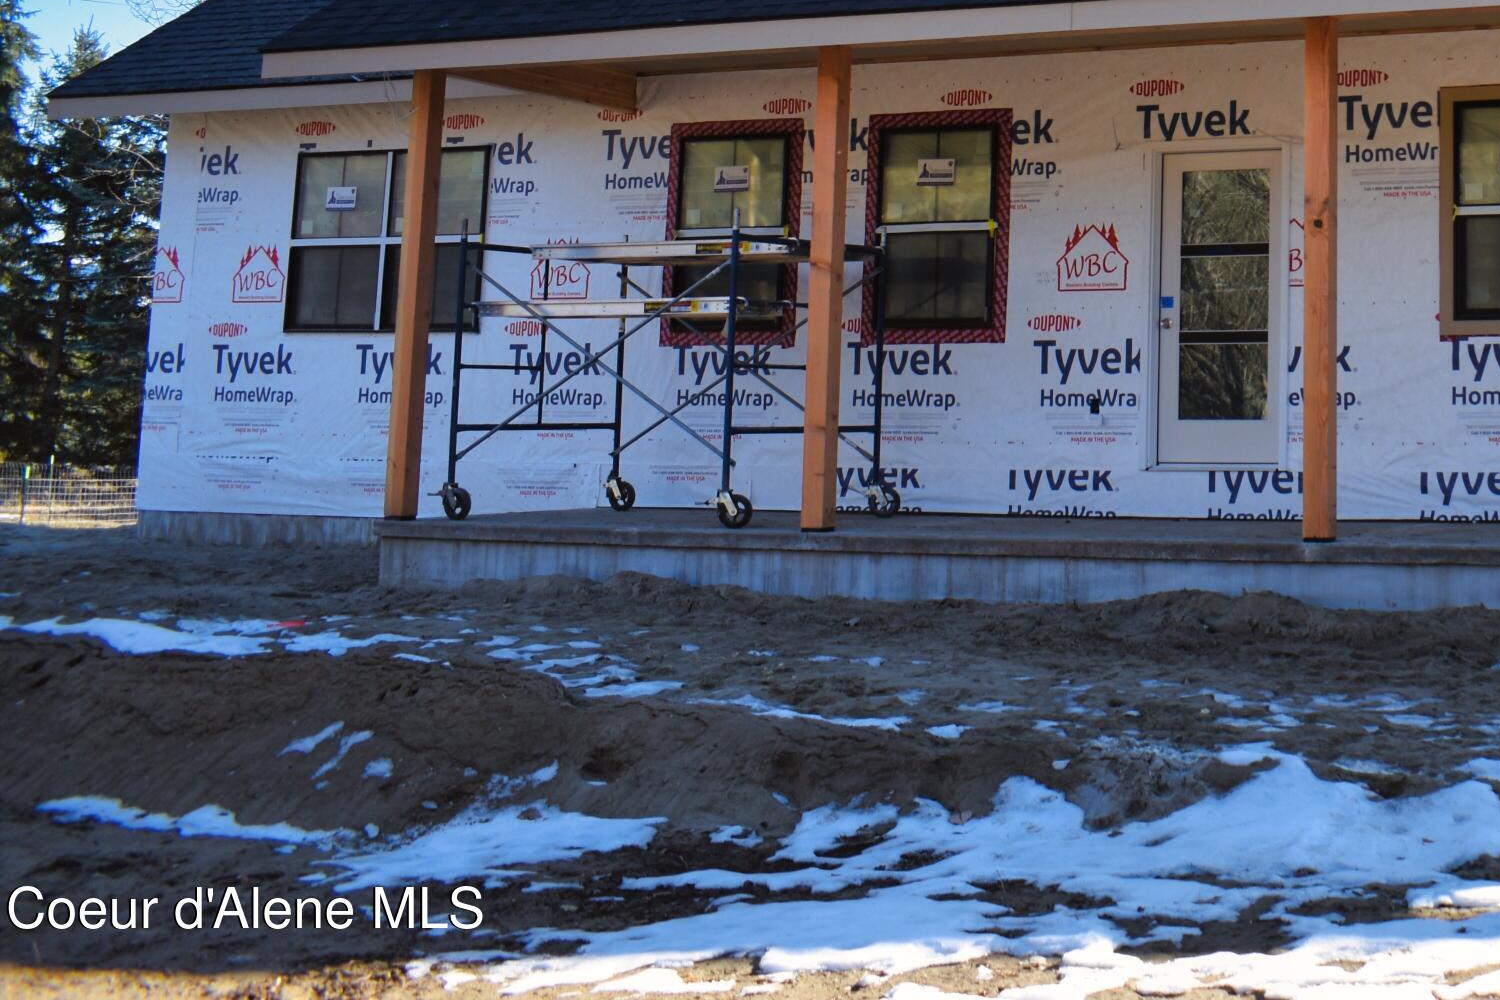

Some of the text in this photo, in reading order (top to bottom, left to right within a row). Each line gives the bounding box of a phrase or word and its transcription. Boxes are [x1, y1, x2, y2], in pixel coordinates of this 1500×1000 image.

[1136, 80, 1178, 96] DUPONT
[1337, 69, 1382, 87] DUPONT
[768, 98, 807, 115] DUPONT
[947, 89, 987, 106] DUPONT
[447, 114, 480, 130] DUPONT
[1136, 100, 1251, 142] Tyvek
[1338, 90, 1440, 140] Tyve
[300, 121, 332, 136] DUPONT
[602, 129, 671, 170] Tyve
[1345, 142, 1438, 163] HomeWr
[605, 173, 669, 190] HomeW
[1064, 250, 1117, 279] WBC
[156, 269, 177, 291] BC
[239, 268, 277, 292] WBC
[212, 322, 244, 338] DUPONT
[1033, 315, 1075, 332] DUPONT
[212, 344, 293, 383] Tyvek
[356, 344, 442, 384] Tyk
[510, 343, 600, 385] Tyvek
[673, 343, 771, 385] Tyvek
[847, 341, 953, 385] Tyvek
[1033, 338, 1141, 385] Tyvek
[214, 386, 293, 406] HomeWrap
[513, 388, 603, 409] HomeWrap
[677, 389, 773, 409] HomeWrap
[852, 389, 956, 411] HomeWrap
[1040, 388, 1138, 408] HomeWra
[1208, 471, 1303, 503] Tyve
